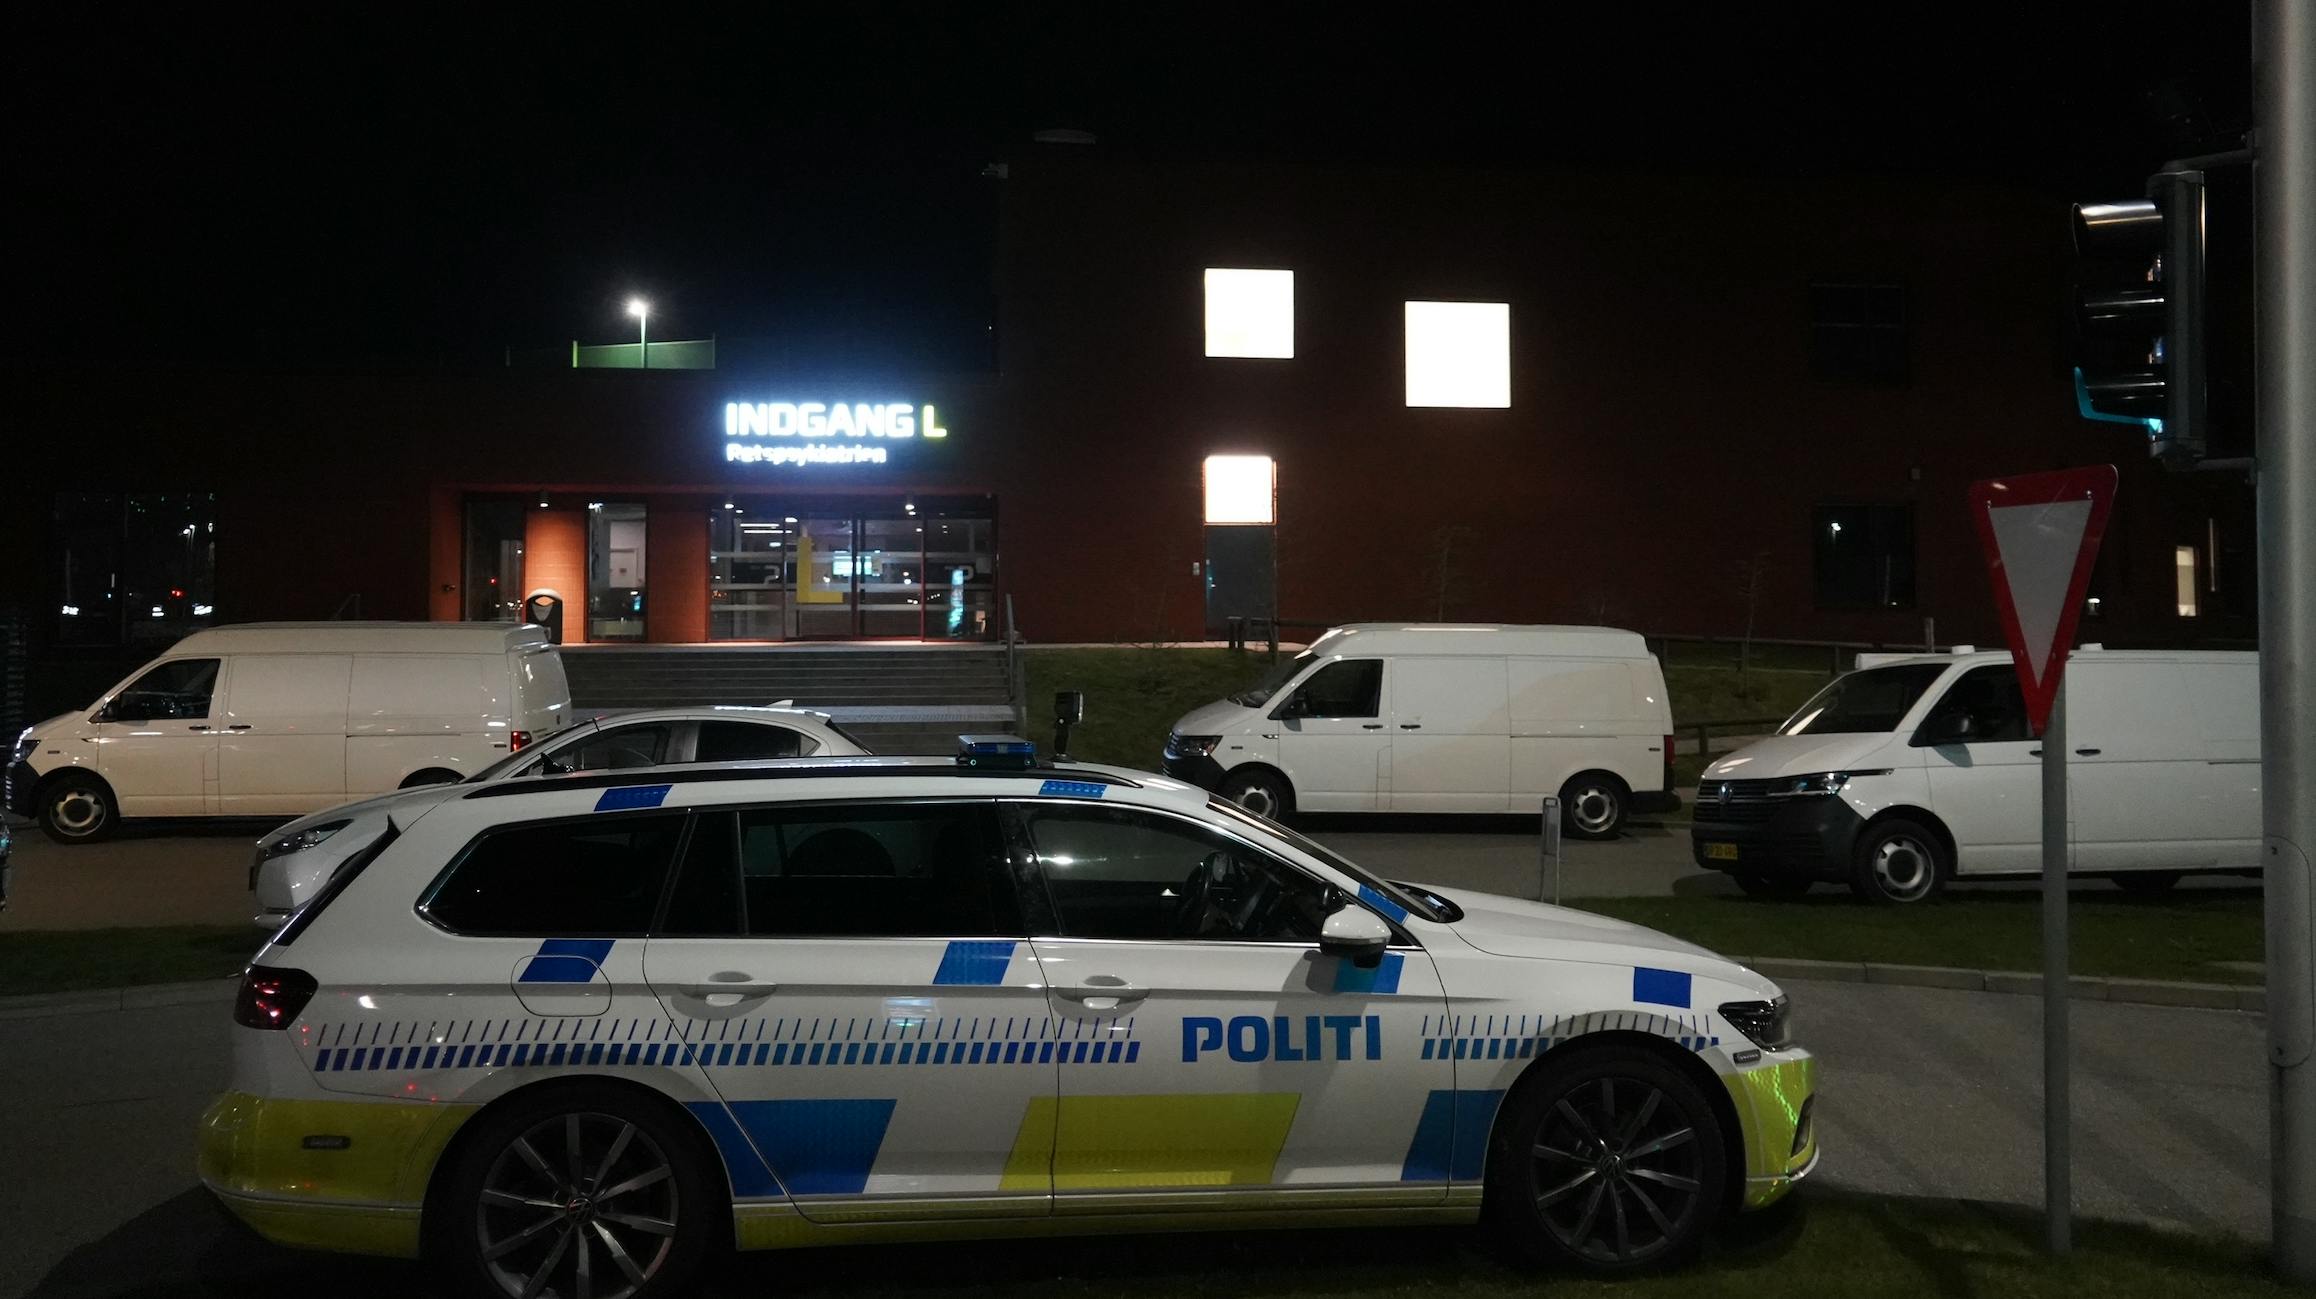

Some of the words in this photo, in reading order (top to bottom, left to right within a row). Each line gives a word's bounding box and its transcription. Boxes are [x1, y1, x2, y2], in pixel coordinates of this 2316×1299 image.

[726, 403, 914, 437] INDGANG
[923, 405, 947, 437] L
[1182, 1015, 1381, 1062] POLITI
